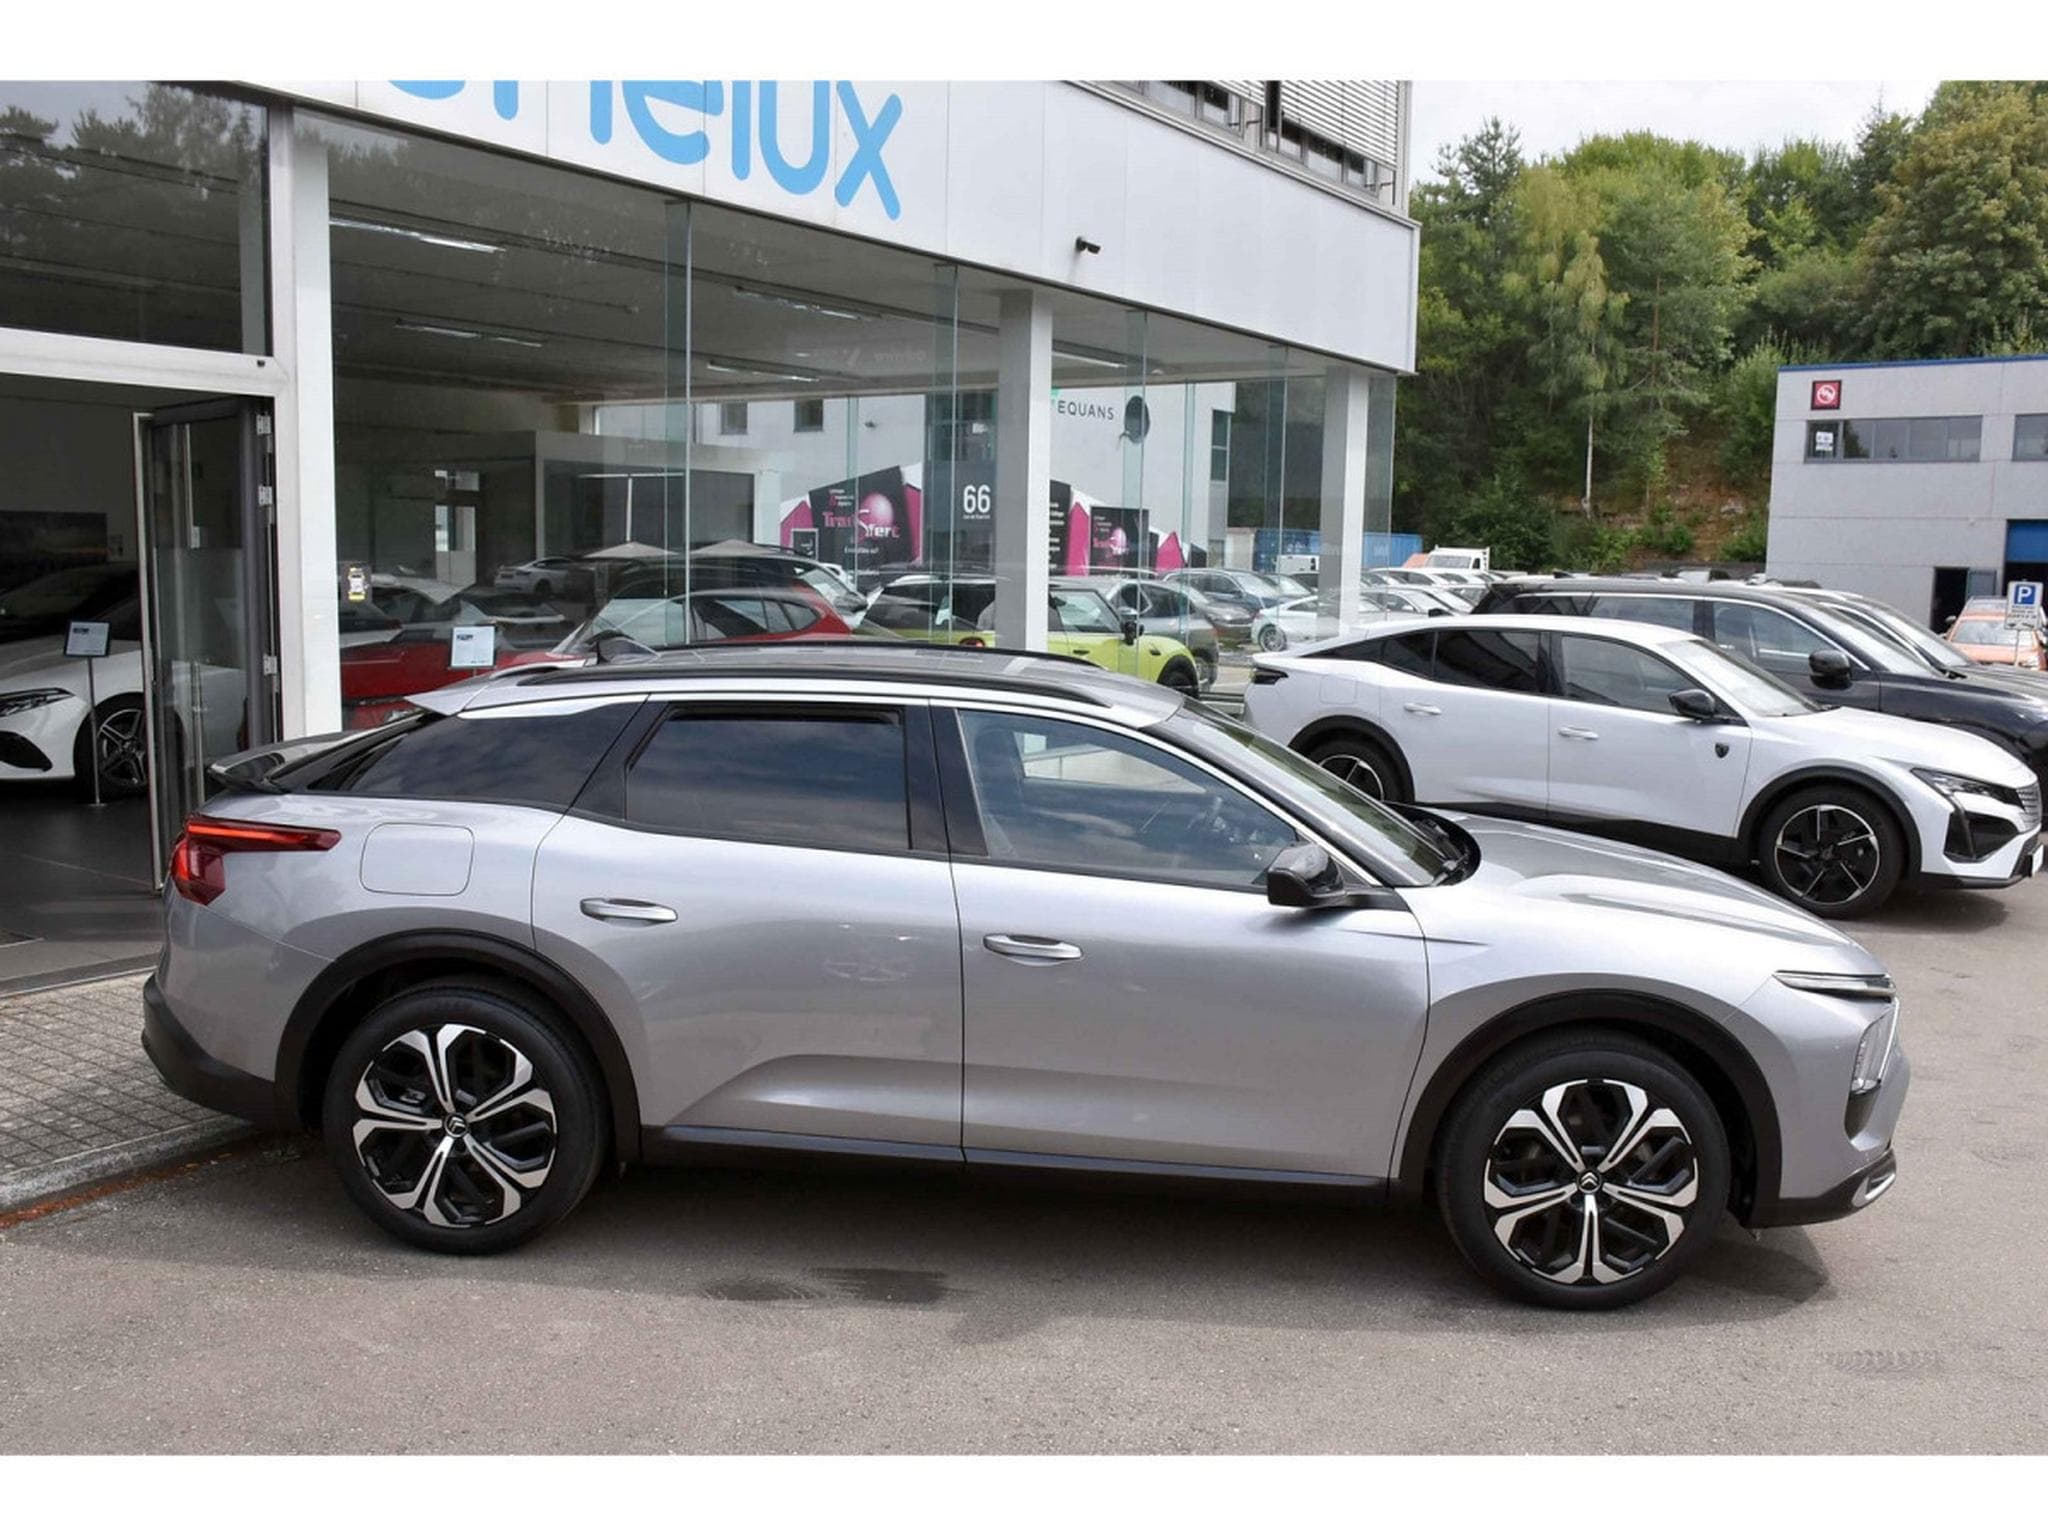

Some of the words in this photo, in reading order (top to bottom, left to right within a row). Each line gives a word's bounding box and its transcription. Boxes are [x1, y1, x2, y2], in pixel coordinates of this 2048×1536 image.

[1057, 400, 1115, 421] EQUANS
[963, 484, 991, 514] 66
[2017, 586, 2032, 603] P
